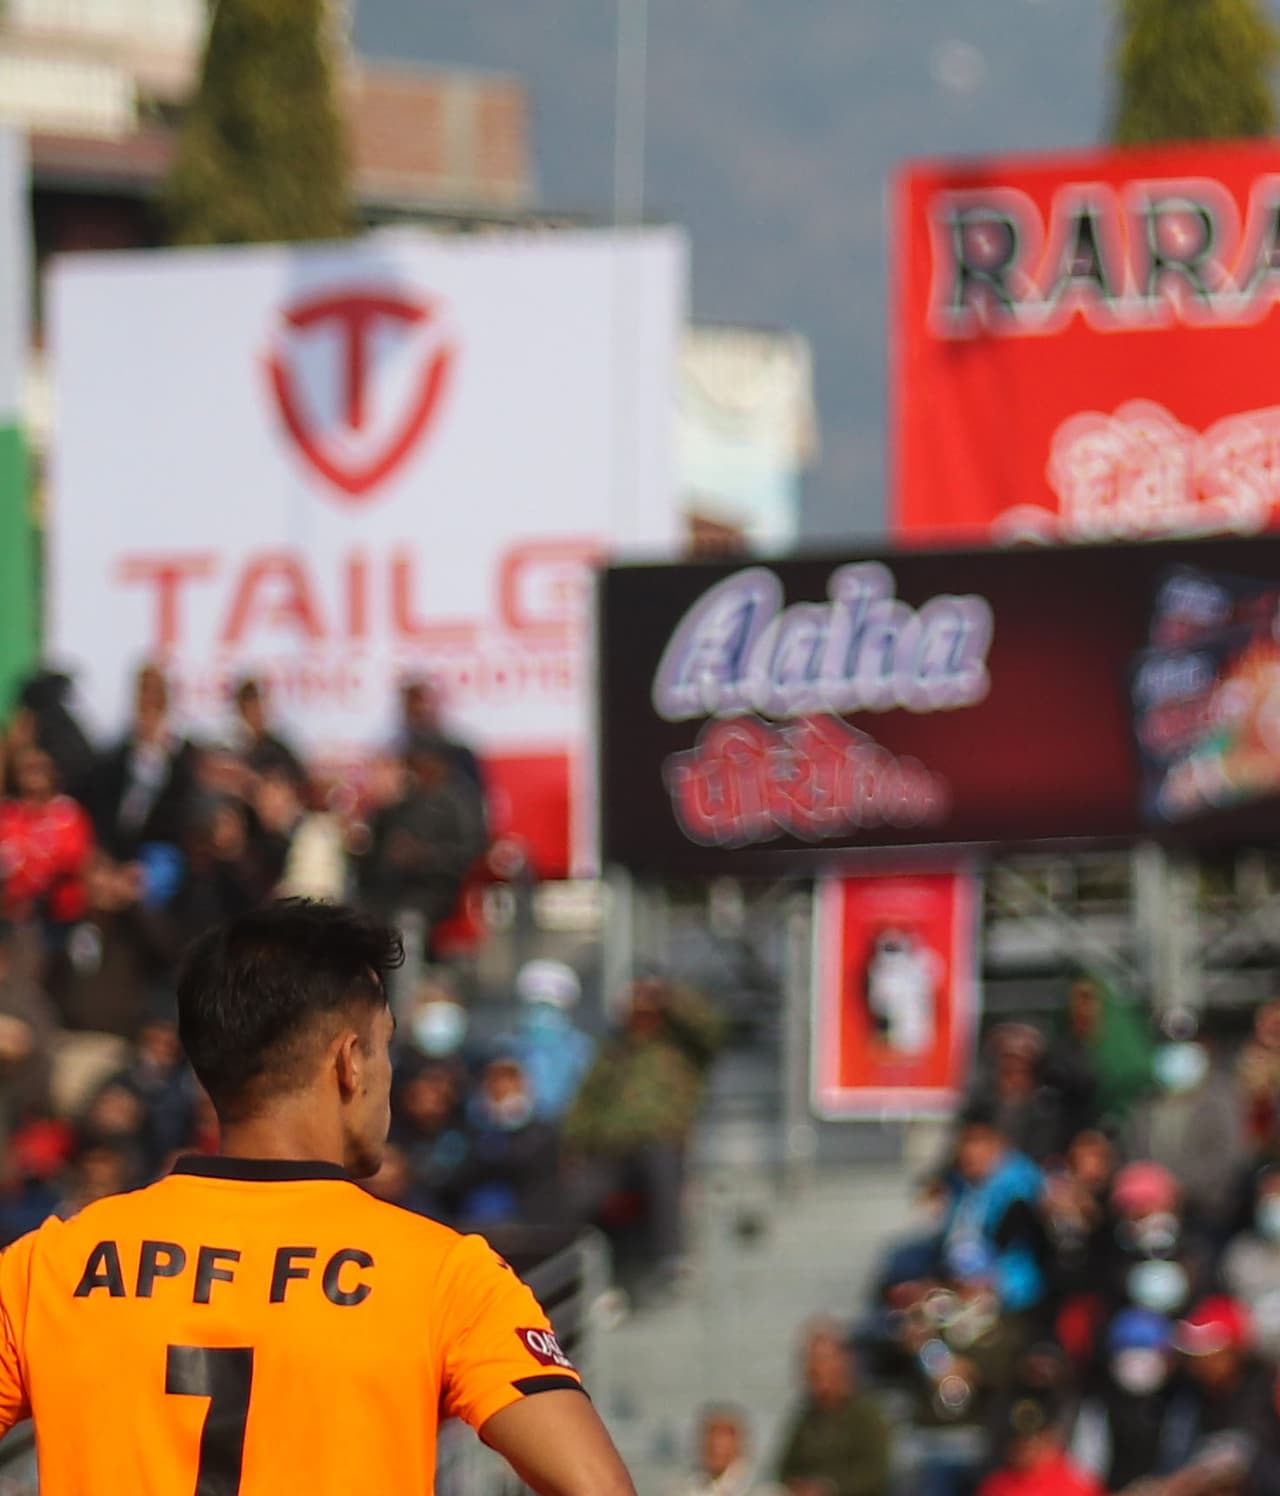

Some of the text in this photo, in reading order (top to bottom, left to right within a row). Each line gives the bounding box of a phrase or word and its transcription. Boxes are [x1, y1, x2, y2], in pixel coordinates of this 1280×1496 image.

[656, 564, 990, 720] Aaha
[73, 1240, 375, 1306] APF FC
